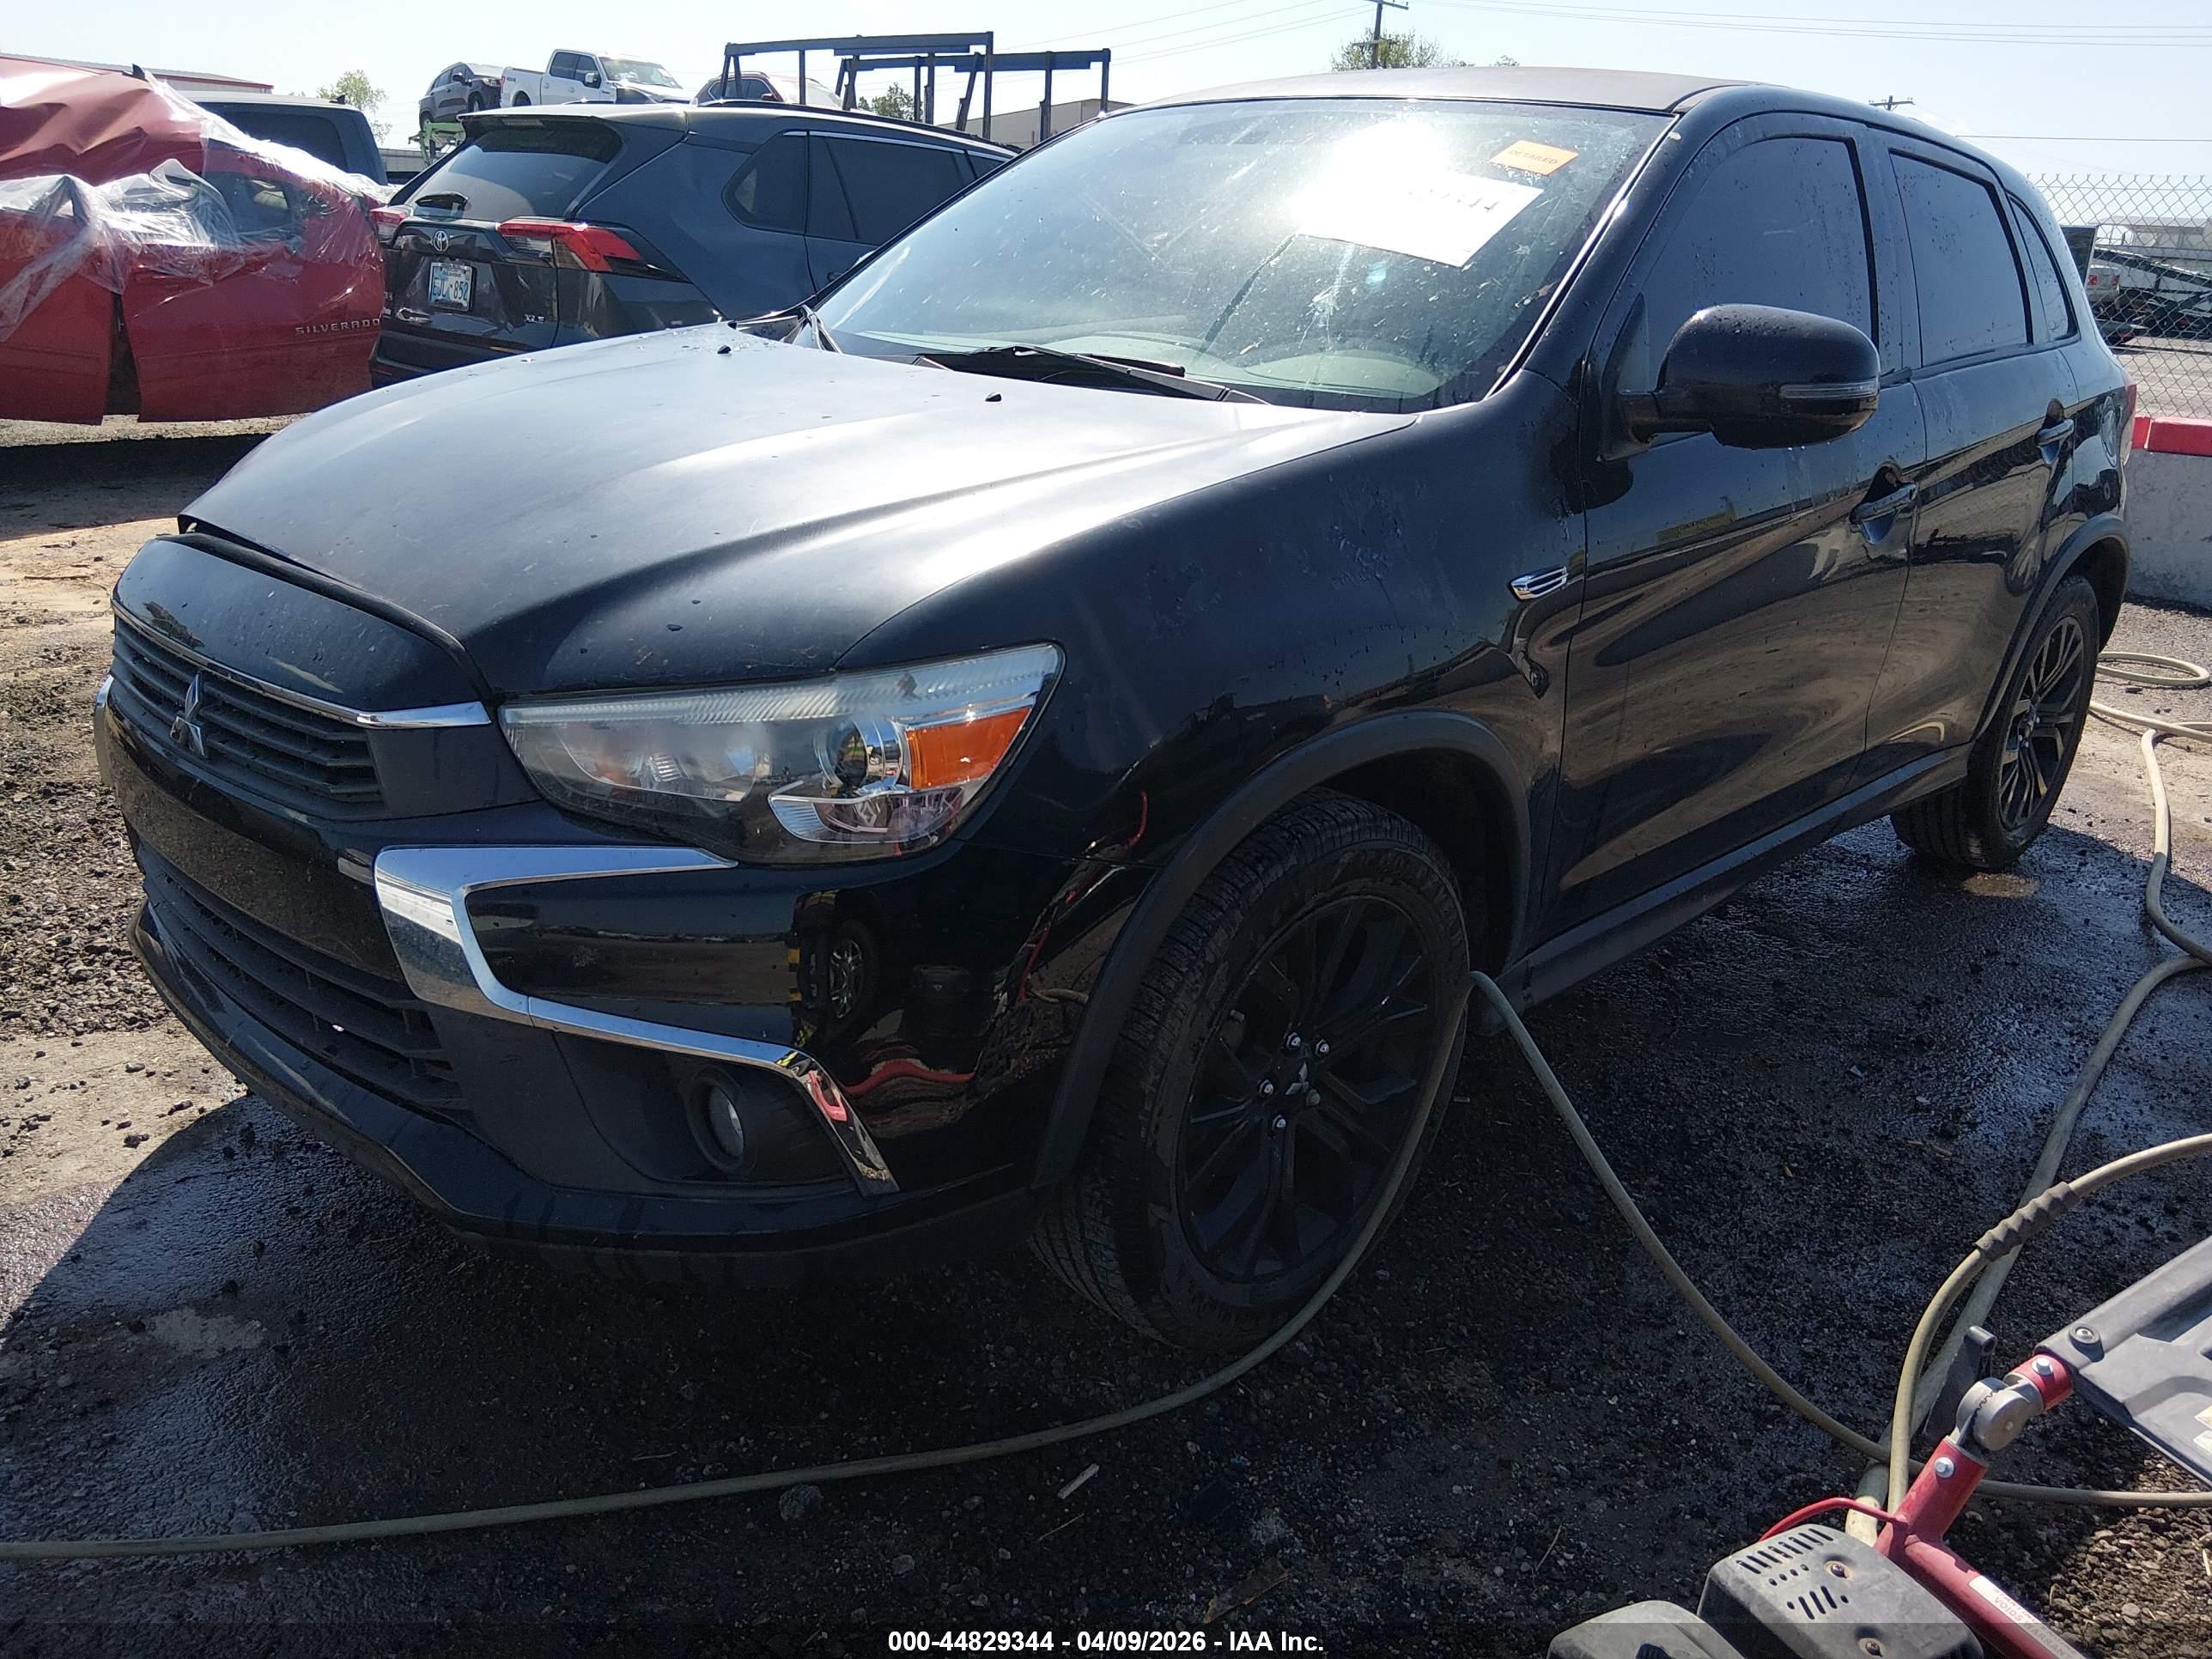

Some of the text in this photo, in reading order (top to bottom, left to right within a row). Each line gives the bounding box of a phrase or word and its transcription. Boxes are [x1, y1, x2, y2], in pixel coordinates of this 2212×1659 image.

[1509, 149, 1558, 165] DETAILED
[453, 280, 469, 301] 852
[295, 318, 380, 335] SILVERADO
[1994, 1596, 2022, 1621] VOIDS
